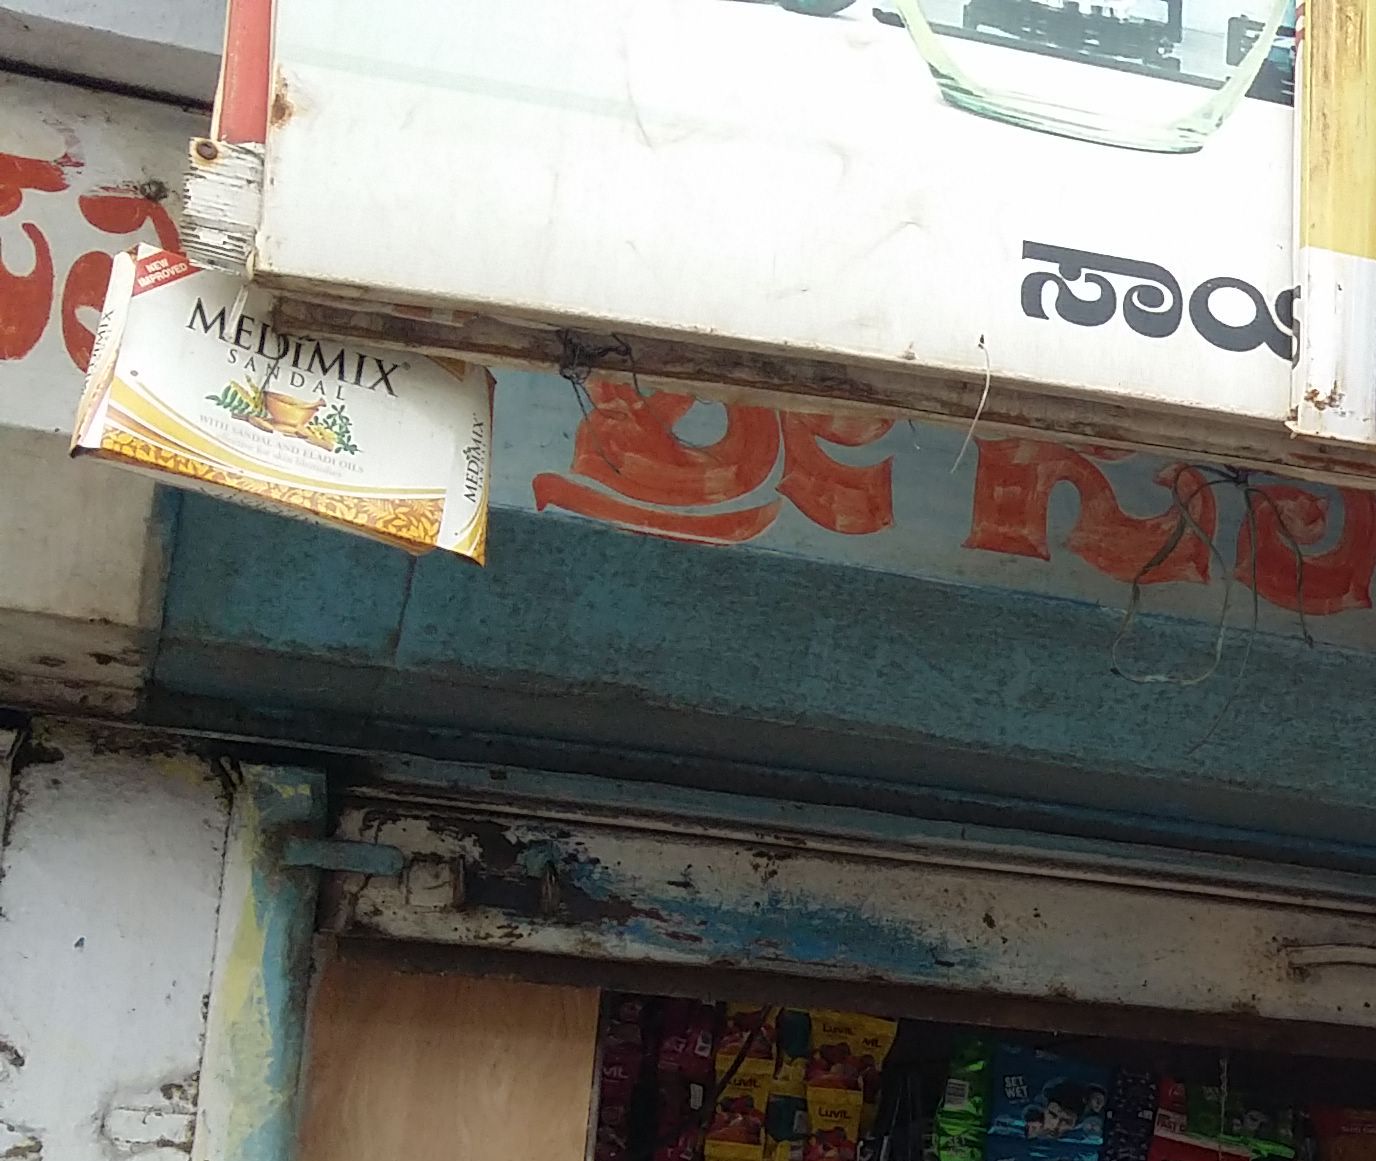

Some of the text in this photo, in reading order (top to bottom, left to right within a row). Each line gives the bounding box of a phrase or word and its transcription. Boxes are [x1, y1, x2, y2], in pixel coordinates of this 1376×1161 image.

[138, 262, 189, 288] IMPROVED
[145, 256, 170, 275] NEW
[227, 348, 346, 402] SANDAL
